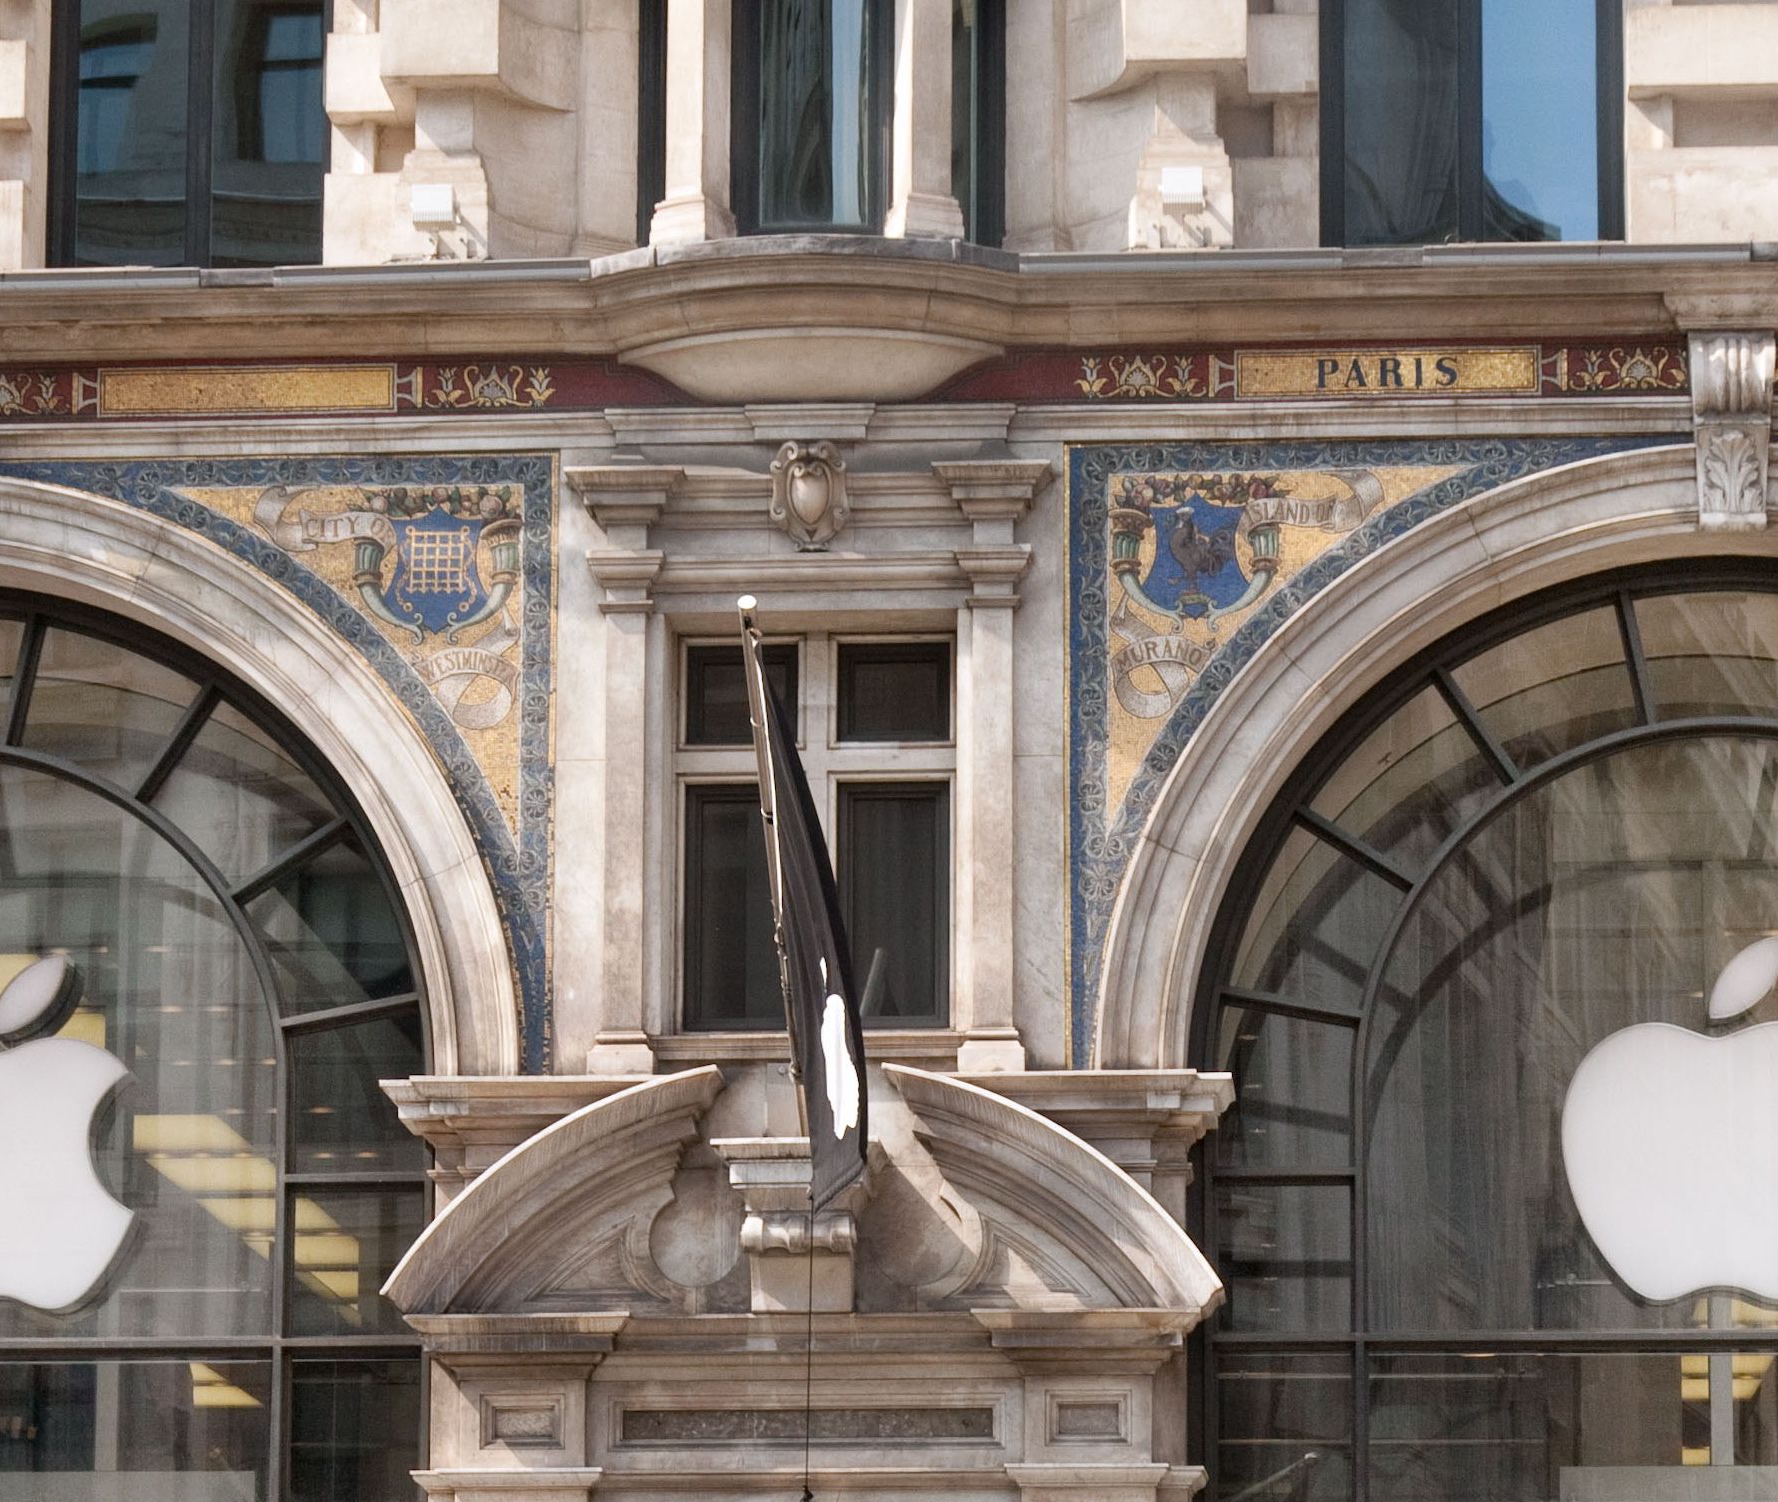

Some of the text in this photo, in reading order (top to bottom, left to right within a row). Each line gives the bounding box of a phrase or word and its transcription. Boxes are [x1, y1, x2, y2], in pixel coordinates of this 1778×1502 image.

[1316, 356, 1458, 388] PARIS
[306, 518, 358, 539] CITY
[1117, 641, 1202, 669] MURANO
